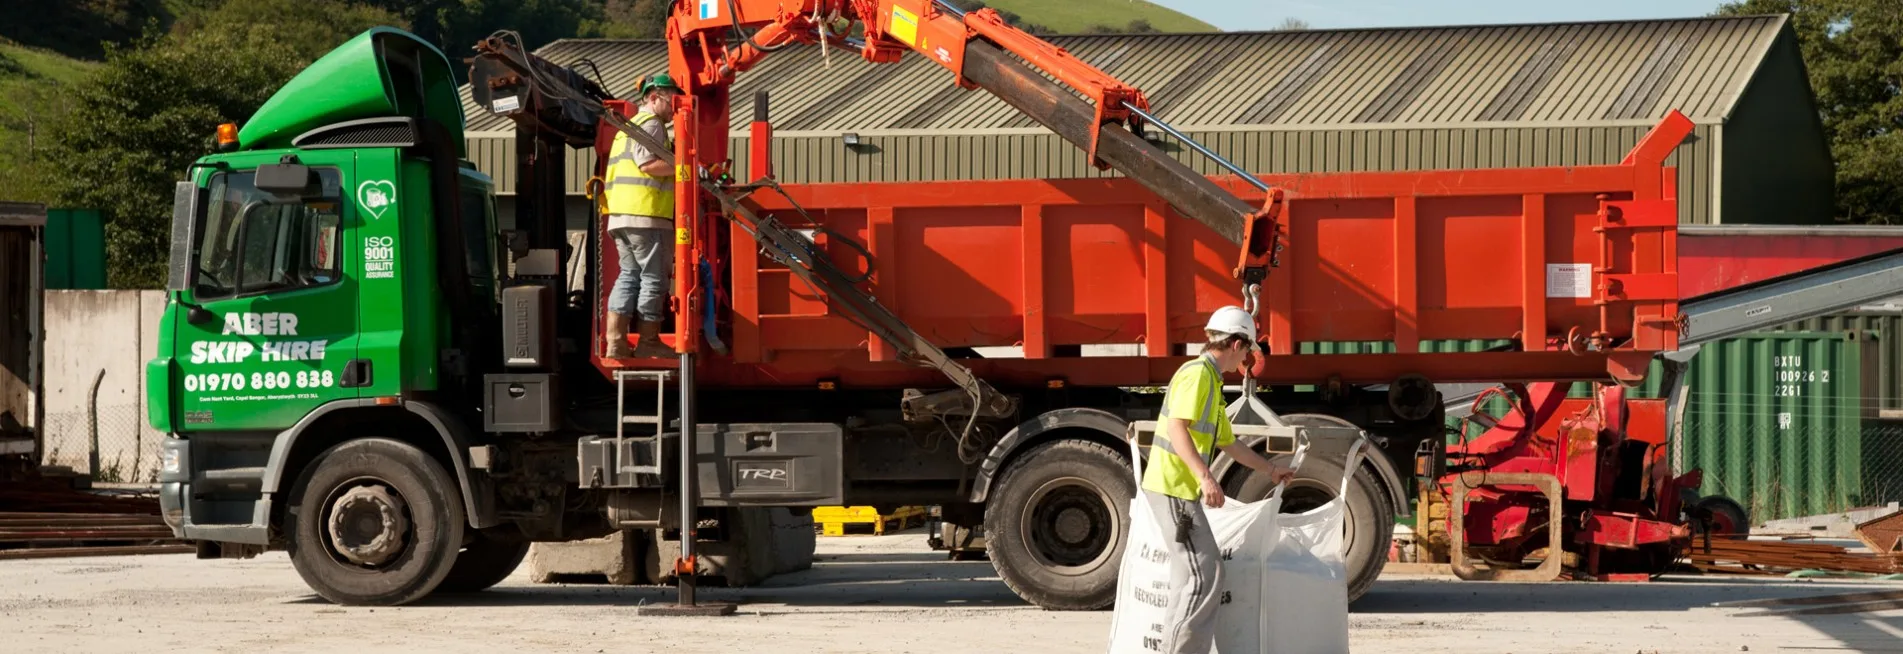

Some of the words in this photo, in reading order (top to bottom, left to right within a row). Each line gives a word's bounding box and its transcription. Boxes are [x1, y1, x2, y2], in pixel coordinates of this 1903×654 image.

[365, 236, 393, 247] ISO
[364, 247, 394, 260] 9001
[365, 262, 394, 272] QUALITY
[222, 312, 298, 336] ABER
[190, 340, 254, 364] SKIP
[261, 339, 328, 362] HIRE
[1774, 356, 1801, 368] BXTU
[184, 373, 245, 392] 01970
[251, 371, 290, 390] 880
[296, 370, 334, 389] 838
[1775, 371, 1815, 382] 100926
[1775, 385, 1801, 397] 22G1
[739, 468, 786, 480] TRP
